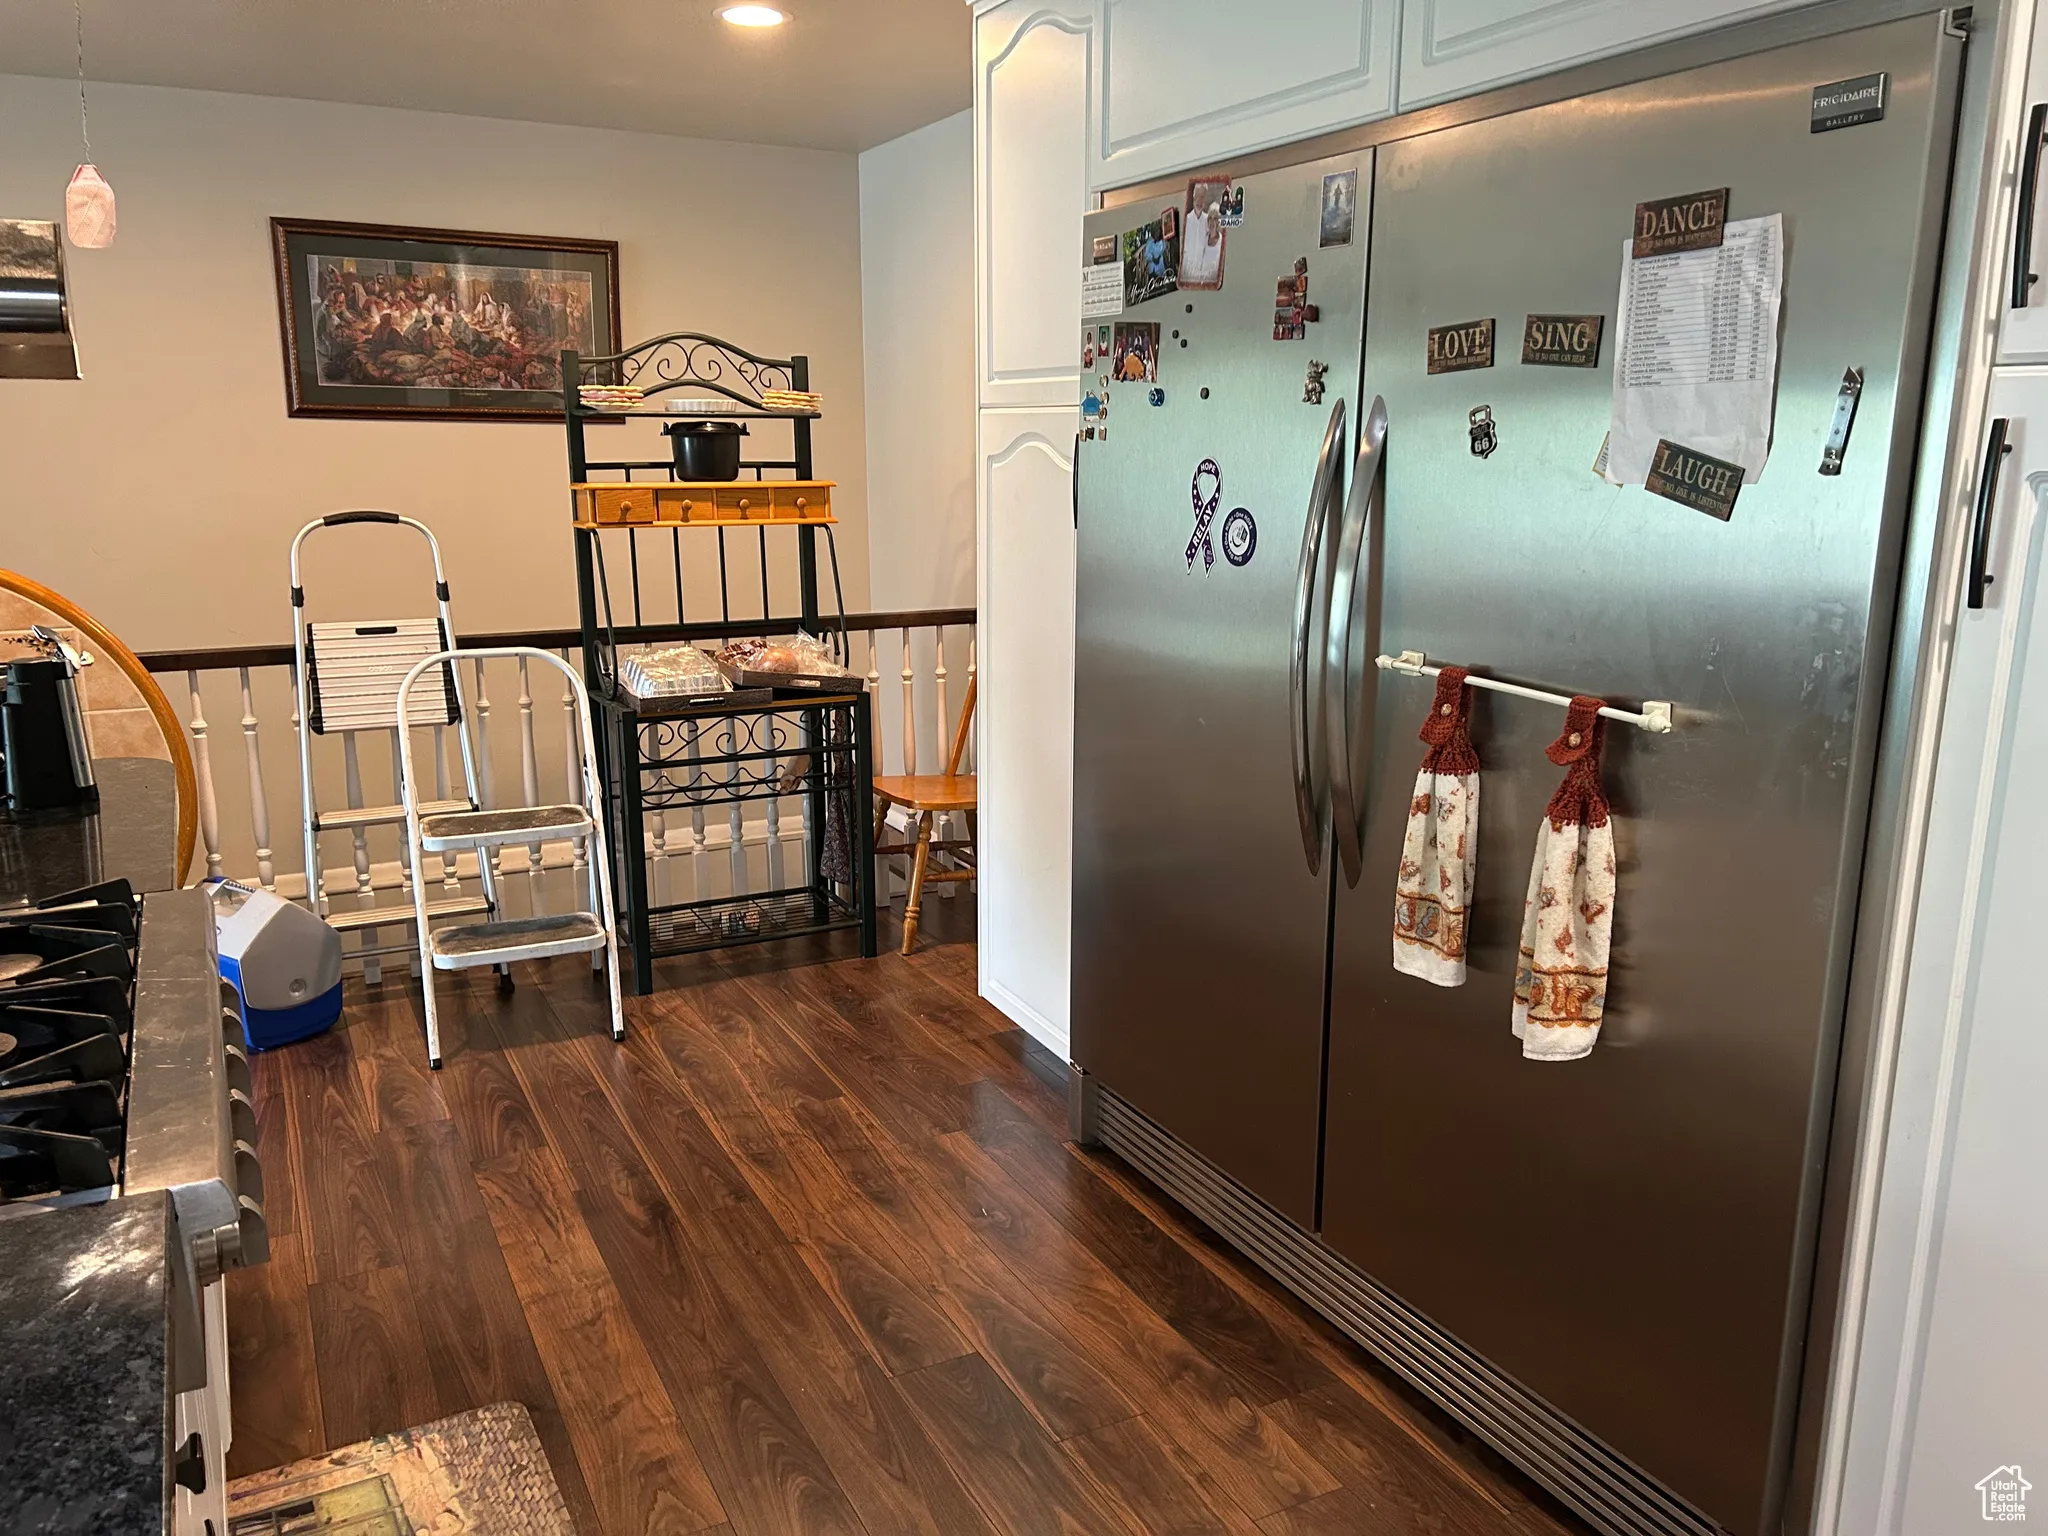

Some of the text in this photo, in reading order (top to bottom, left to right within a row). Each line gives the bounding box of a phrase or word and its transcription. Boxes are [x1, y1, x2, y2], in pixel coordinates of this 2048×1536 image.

[1813, 86, 1879, 109] FRIGIDAIRE
[1826, 113, 1865, 127] GALLERY
[1220, 219, 1240, 227] IDAHO
[1640, 199, 1717, 239] DANCE
[1432, 326, 1487, 361] LOVE
[1528, 321, 1590, 352] SING
[1474, 437, 1490, 453] 66
[1200, 462, 1216, 474] HOPE
[1657, 449, 1732, 496] LAUGH
[1676, 485, 1688, 498] ONE
[1689, 491, 1697, 501] IS
[1192, 505, 1213, 548] RELAY
